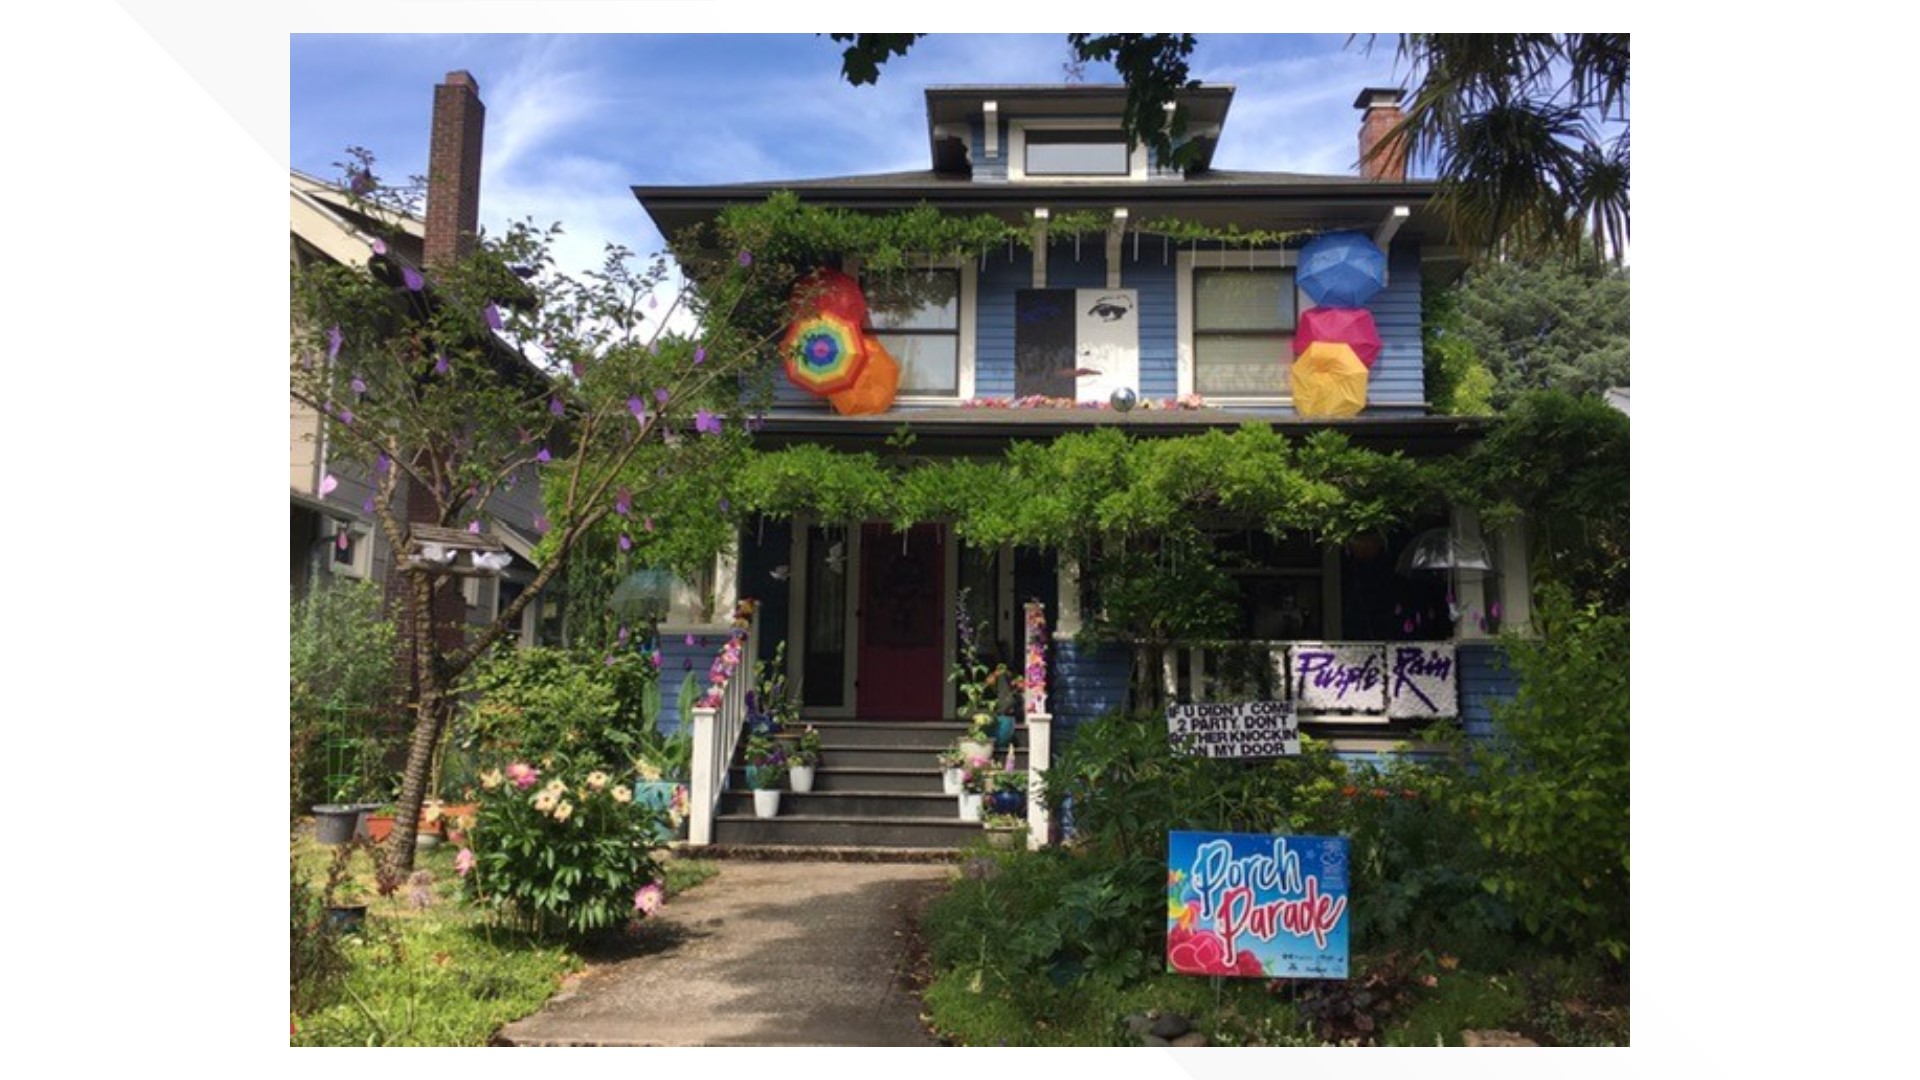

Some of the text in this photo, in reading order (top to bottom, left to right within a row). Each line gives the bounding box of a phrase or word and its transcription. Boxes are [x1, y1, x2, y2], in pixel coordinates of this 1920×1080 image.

[1295, 647, 1452, 713] Purple Rain
[1168, 705, 1180, 718] IF
[1184, 704, 1195, 717] U
[1250, 702, 1294, 715] COME
[1177, 718, 1187, 732] 2
[1188, 743, 1285, 757] ON MY DOOR
[1191, 837, 1303, 919] Porch
[1214, 874, 1348, 967] Parade
